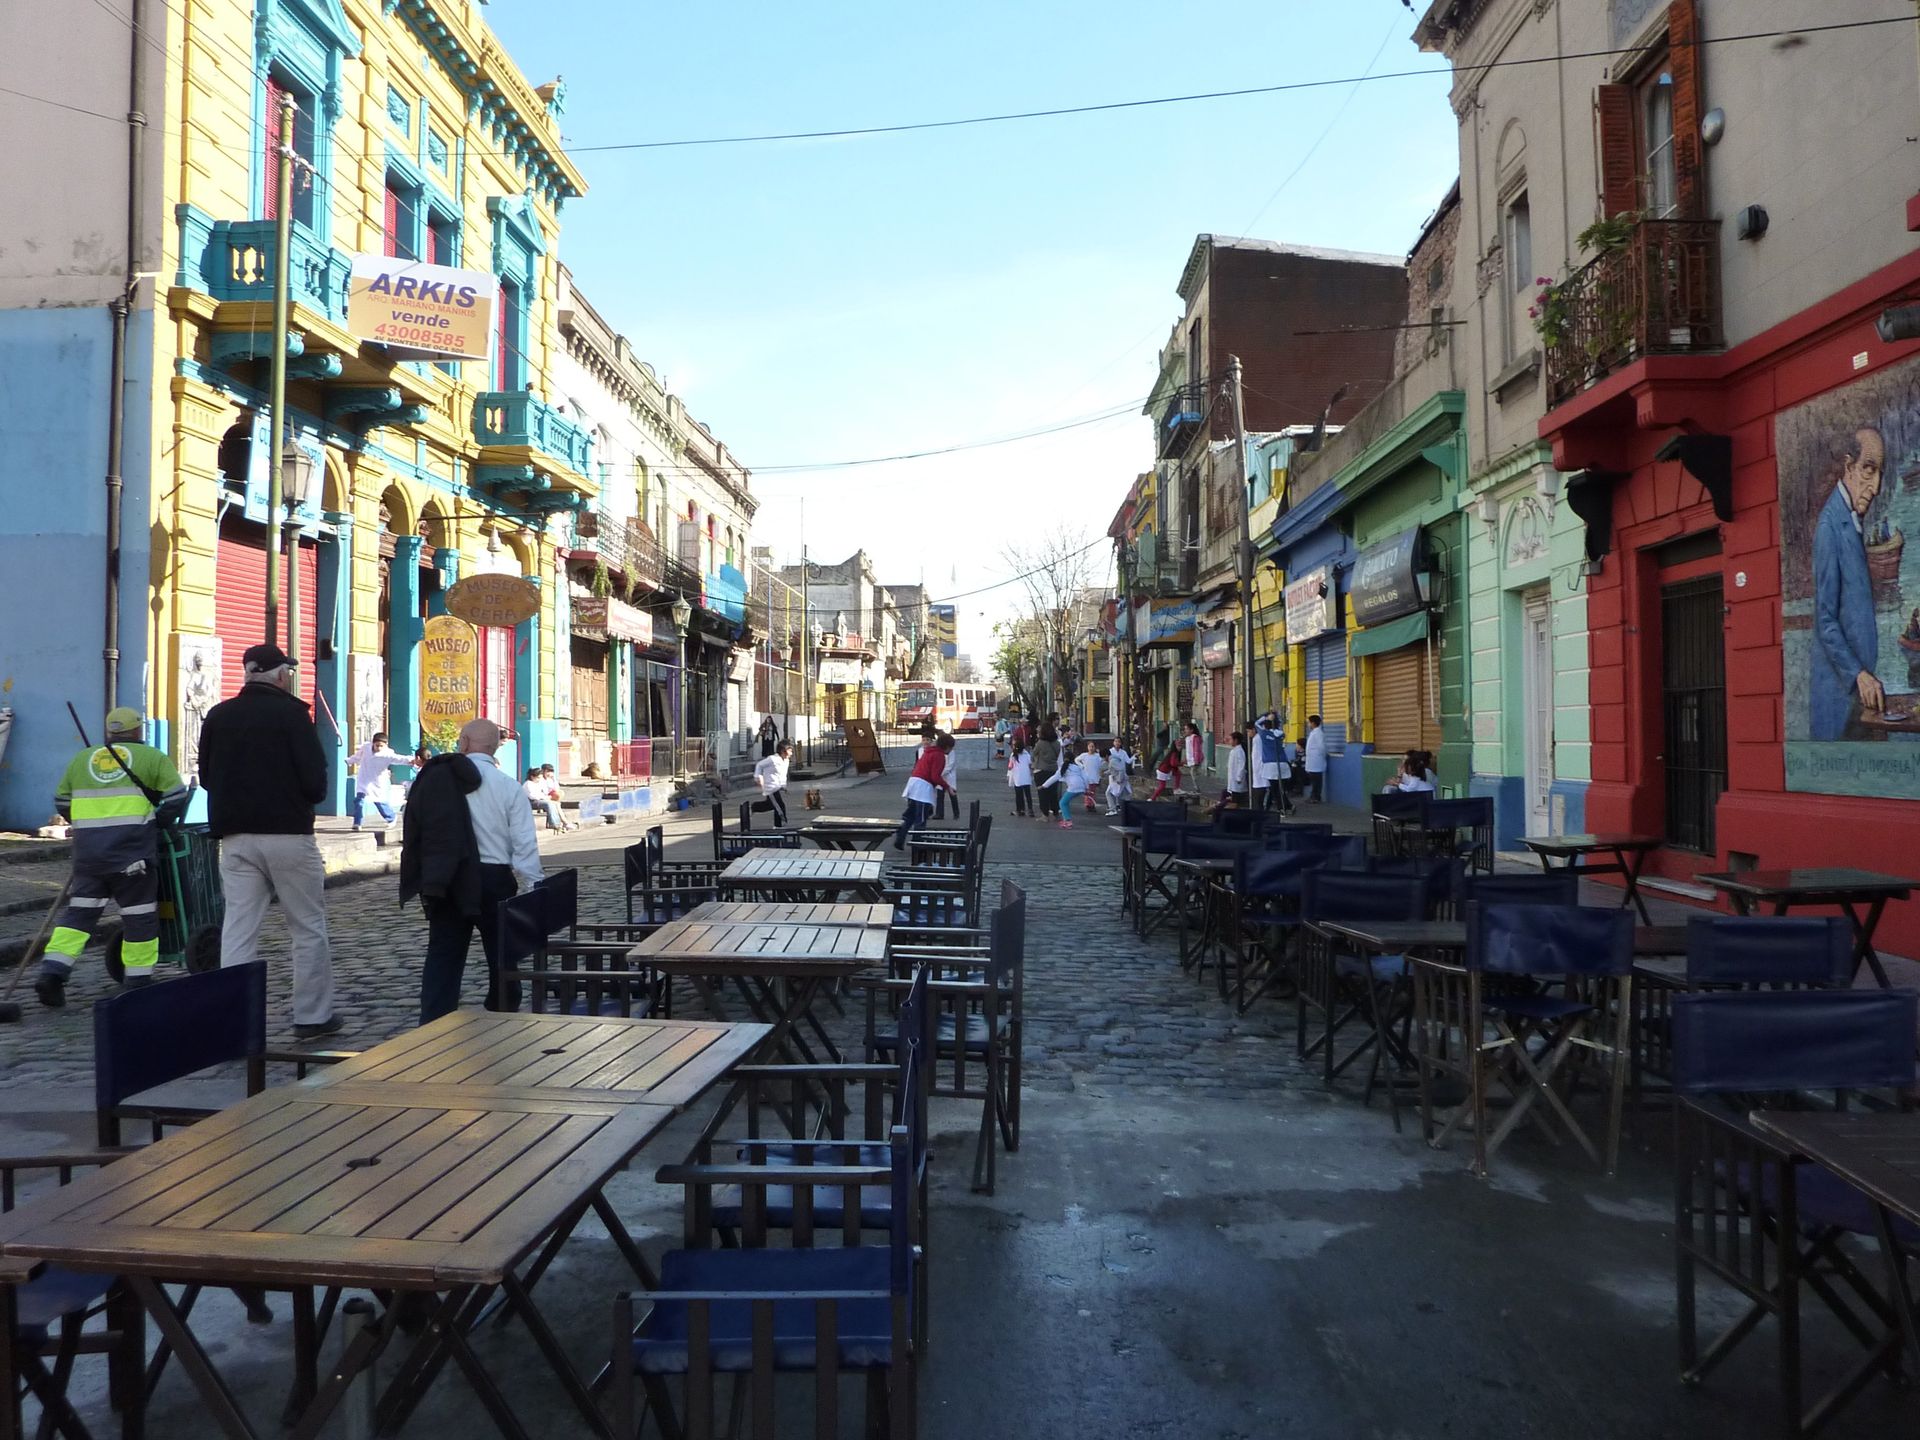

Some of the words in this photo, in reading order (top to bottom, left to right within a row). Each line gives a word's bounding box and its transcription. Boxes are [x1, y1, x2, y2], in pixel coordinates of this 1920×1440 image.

[368, 273, 478, 309] ARKIS
[391, 297, 435, 311] MARIANO
[391, 310, 450, 329] vende
[374, 323, 465, 347] 43008585
[387, 337, 419, 347] MONTES
[433, 344, 449, 352] OCA
[465, 578, 521, 594] MUSEO
[485, 594, 504, 604] DE
[1364, 589, 1398, 609] REGALOS
[470, 606, 517, 620] CERA
[425, 637, 471, 655] MUSEO
[442, 661, 456, 670] DE
[428, 672, 470, 693] CERA
[425, 698, 473, 716] HISTORICO
